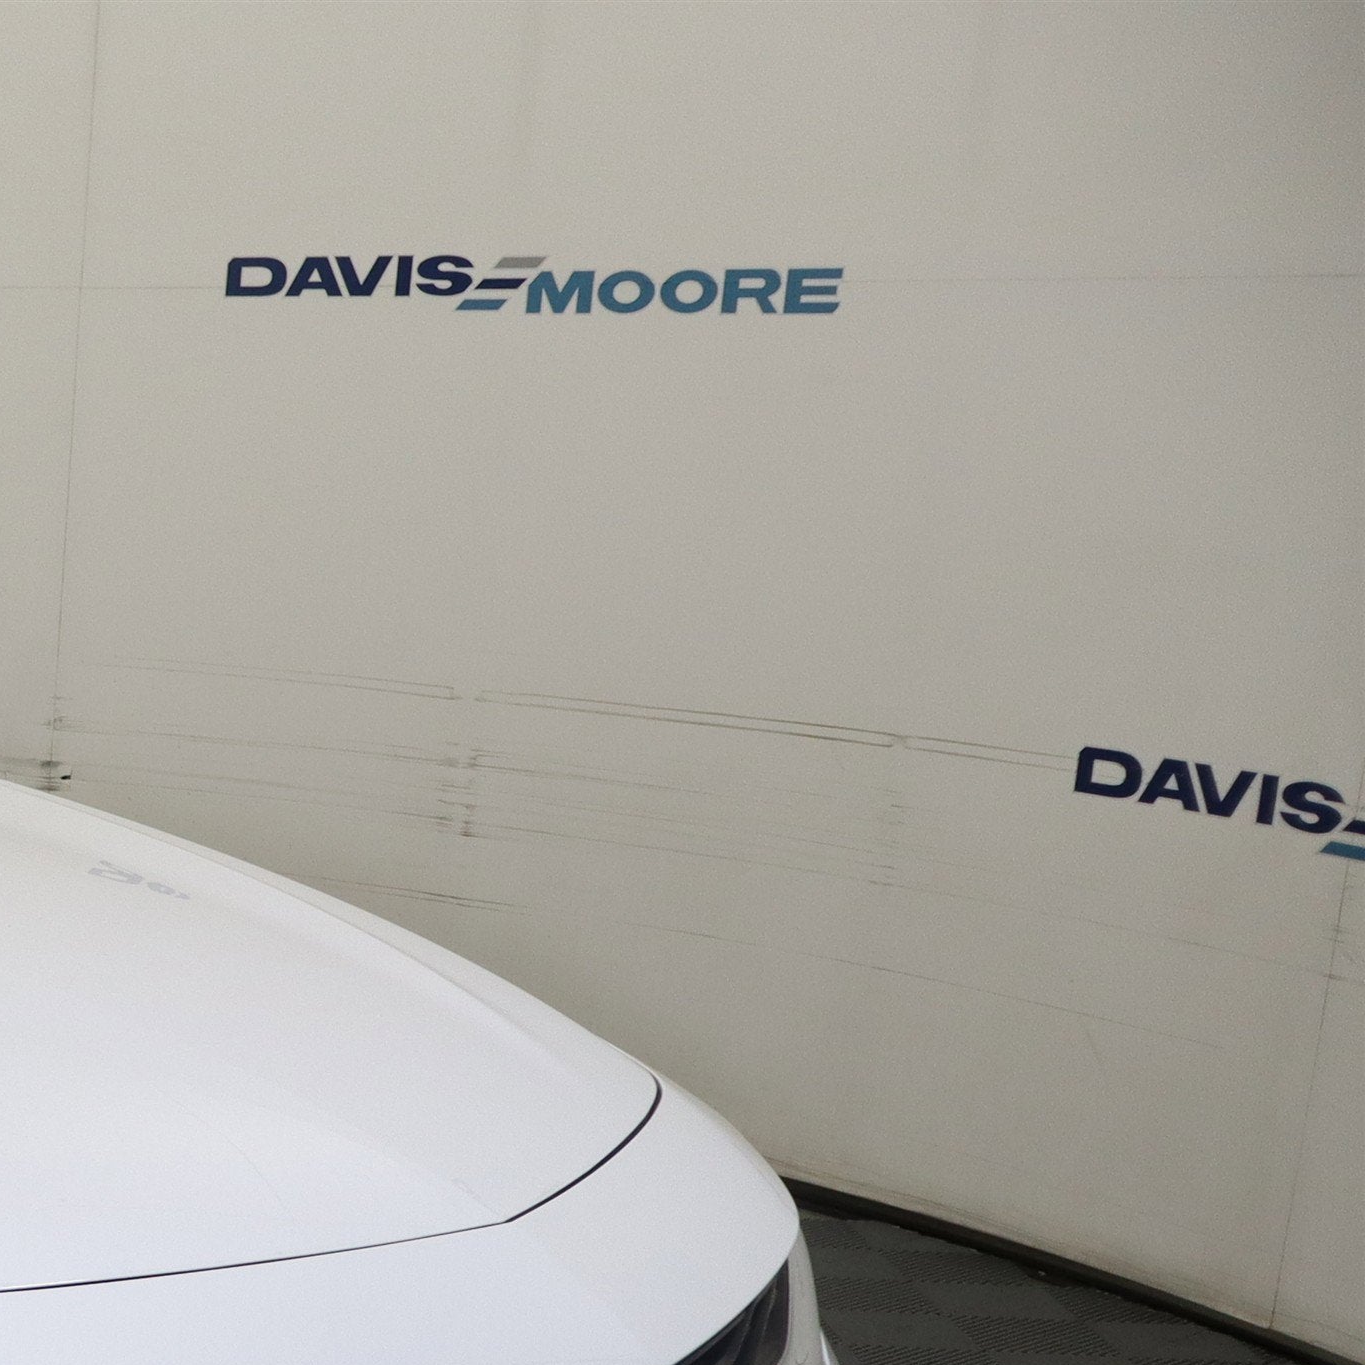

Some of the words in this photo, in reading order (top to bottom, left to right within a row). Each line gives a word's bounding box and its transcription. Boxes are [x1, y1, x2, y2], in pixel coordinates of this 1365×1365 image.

[225, 254, 475, 297] DAVIS
[525, 267, 844, 314] MOORE
[1072, 745, 1347, 834] DAVIS
